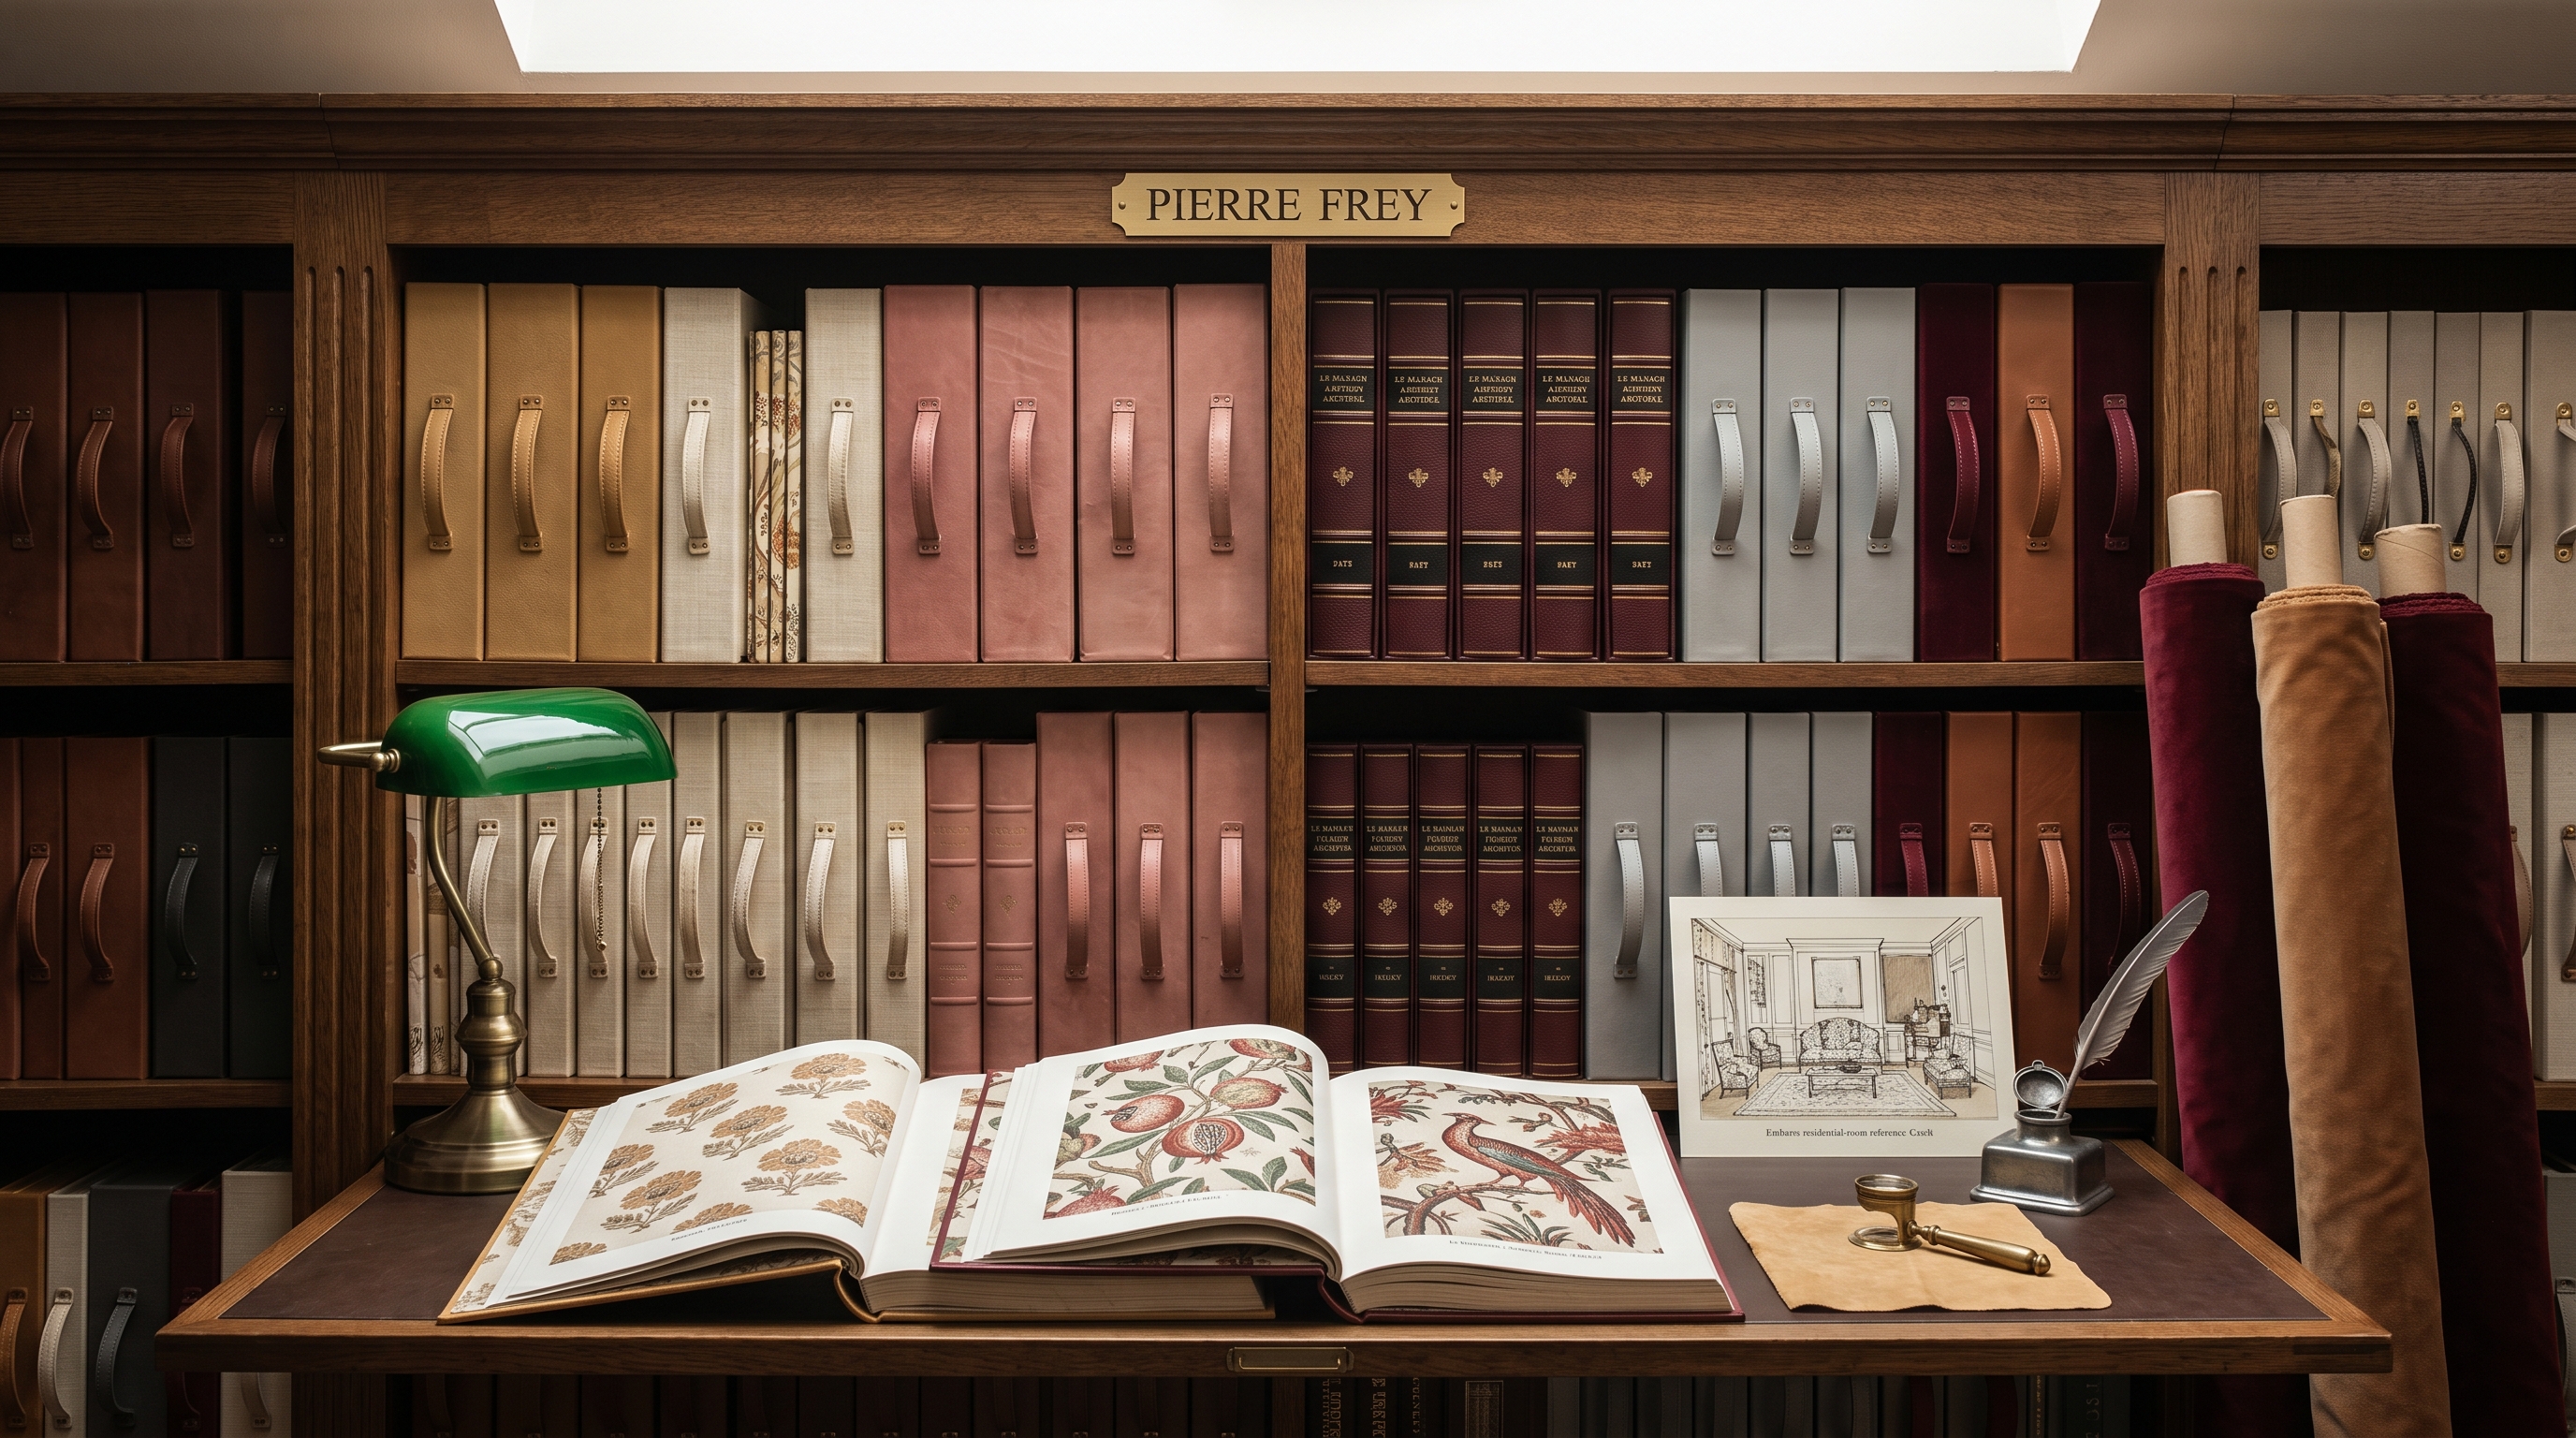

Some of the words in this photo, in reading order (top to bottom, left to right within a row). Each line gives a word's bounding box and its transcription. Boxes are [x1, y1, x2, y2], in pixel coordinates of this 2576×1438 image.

[1146, 188, 1302, 221] PIERRE
[1318, 188, 1432, 221] FREY
[1765, 1128, 1801, 1137] Embares
[1803, 1128, 1867, 1137] residential-room
[1869, 1128, 1907, 1137] reference
